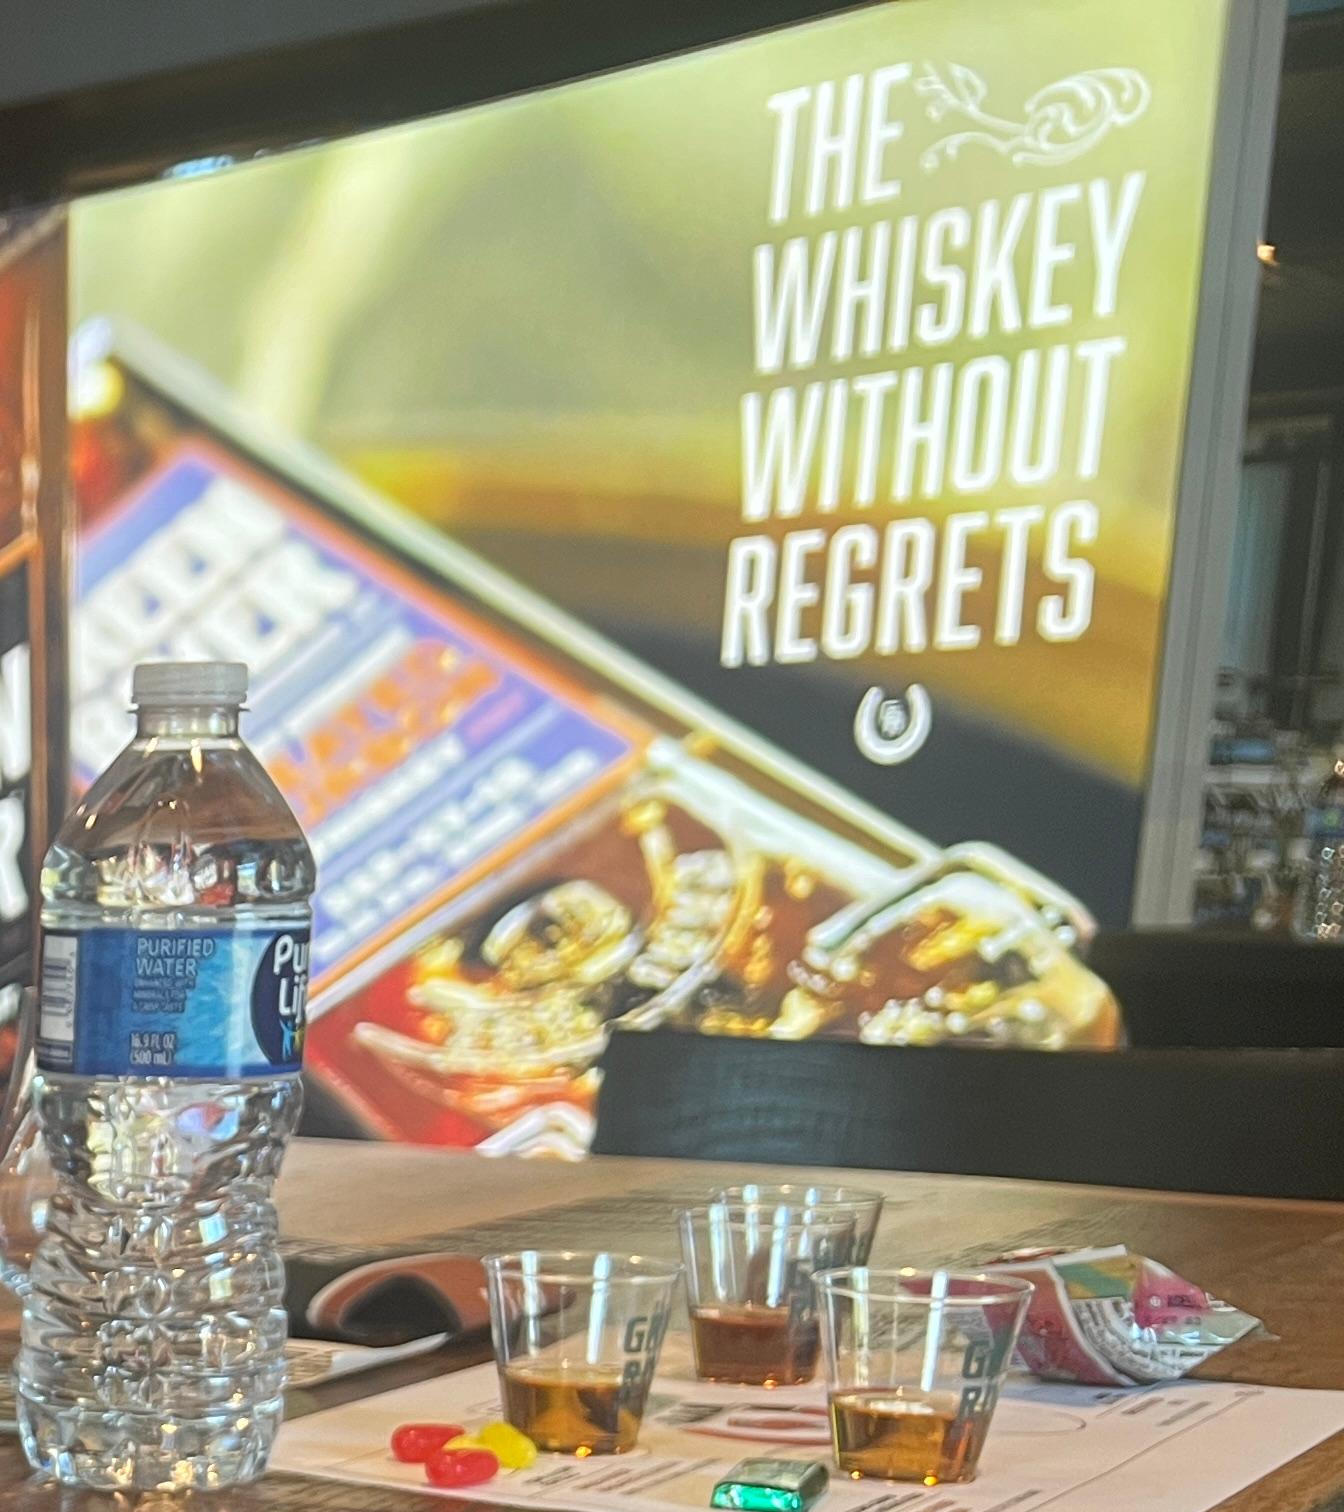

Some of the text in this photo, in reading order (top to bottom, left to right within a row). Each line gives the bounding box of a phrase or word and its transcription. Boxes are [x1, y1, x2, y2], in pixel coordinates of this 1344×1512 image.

[767, 61, 912, 228] THE
[752, 169, 1147, 377] WHISKEY
[740, 335, 1127, 524] WITHOUT
[719, 499, 1099, 669] REGRETS
[135, 957, 197, 977] WATER
[137, 937, 215, 957] PURIFIED
